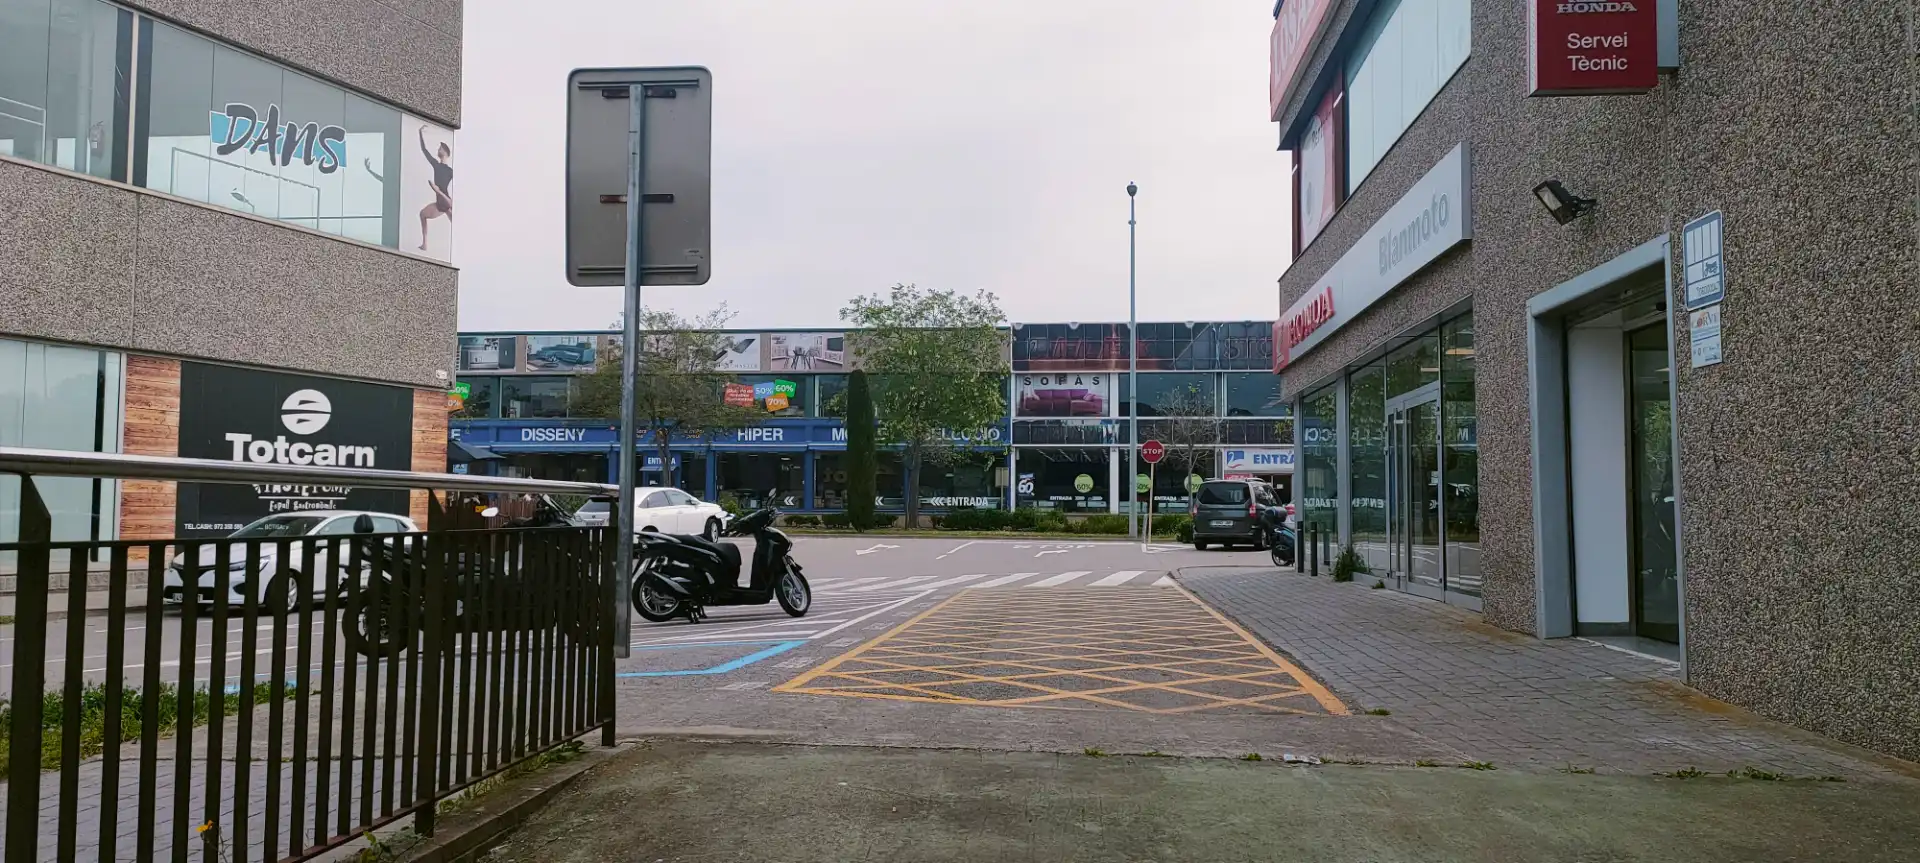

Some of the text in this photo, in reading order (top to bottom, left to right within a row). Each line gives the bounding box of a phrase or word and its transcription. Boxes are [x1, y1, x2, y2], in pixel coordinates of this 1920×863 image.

[1556, 2, 1638, 14] HONDA
[1567, 32, 1629, 49] Servei
[1567, 55, 1629, 71] Tècnic
[1378, 192, 1450, 277] Blanmoto
[1287, 285, 1336, 349] HONDA
[1023, 375, 1101, 386] SOFÀS
[755, 386, 774, 395] 50%
[774, 384, 794, 393] 60%
[768, 397, 787, 407] 70%
[521, 428, 586, 441] DISSENY
[737, 427, 784, 441] HIPER
[225, 432, 376, 468] Totcarn
[947, 496, 988, 507] ENTRADA
